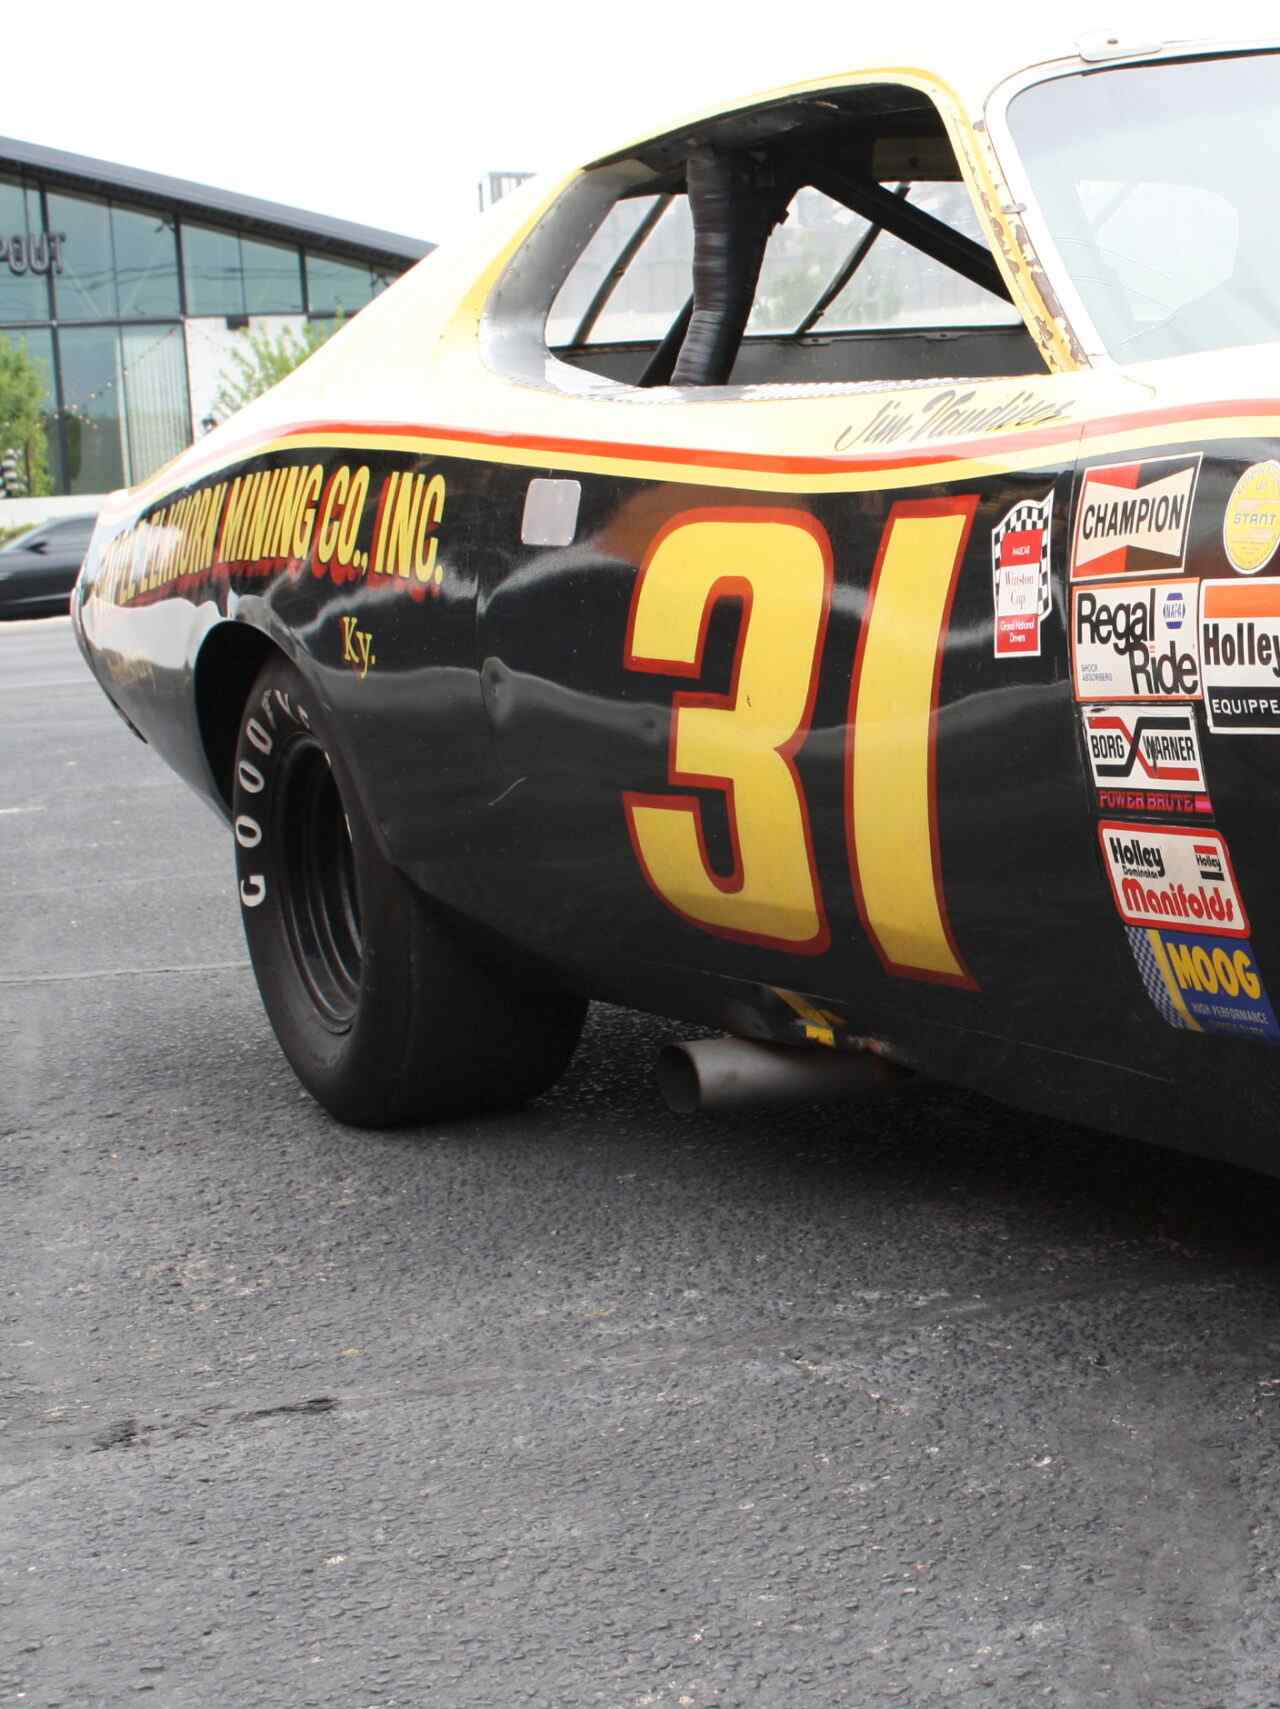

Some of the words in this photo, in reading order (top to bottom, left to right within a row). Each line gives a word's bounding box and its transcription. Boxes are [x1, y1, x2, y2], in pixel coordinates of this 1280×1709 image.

[218, 464, 324, 563] MINING
[375, 471, 446, 586] INC.
[1082, 493, 1185, 540] CHAMPION
[341, 617, 376, 679] Ky.
[1077, 588, 1157, 656] Regal
[1127, 640, 1198, 694] Ride
[622, 494, 982, 993] 31
[1090, 735, 1125, 760] BORG
[1142, 735, 1196, 762] WARNER
[1109, 837, 1166, 878] Holley
[1196, 854, 1222, 872] Holley
[1121, 877, 1234, 922] Manifolds
[1166, 942, 1262, 1001] MOOG
